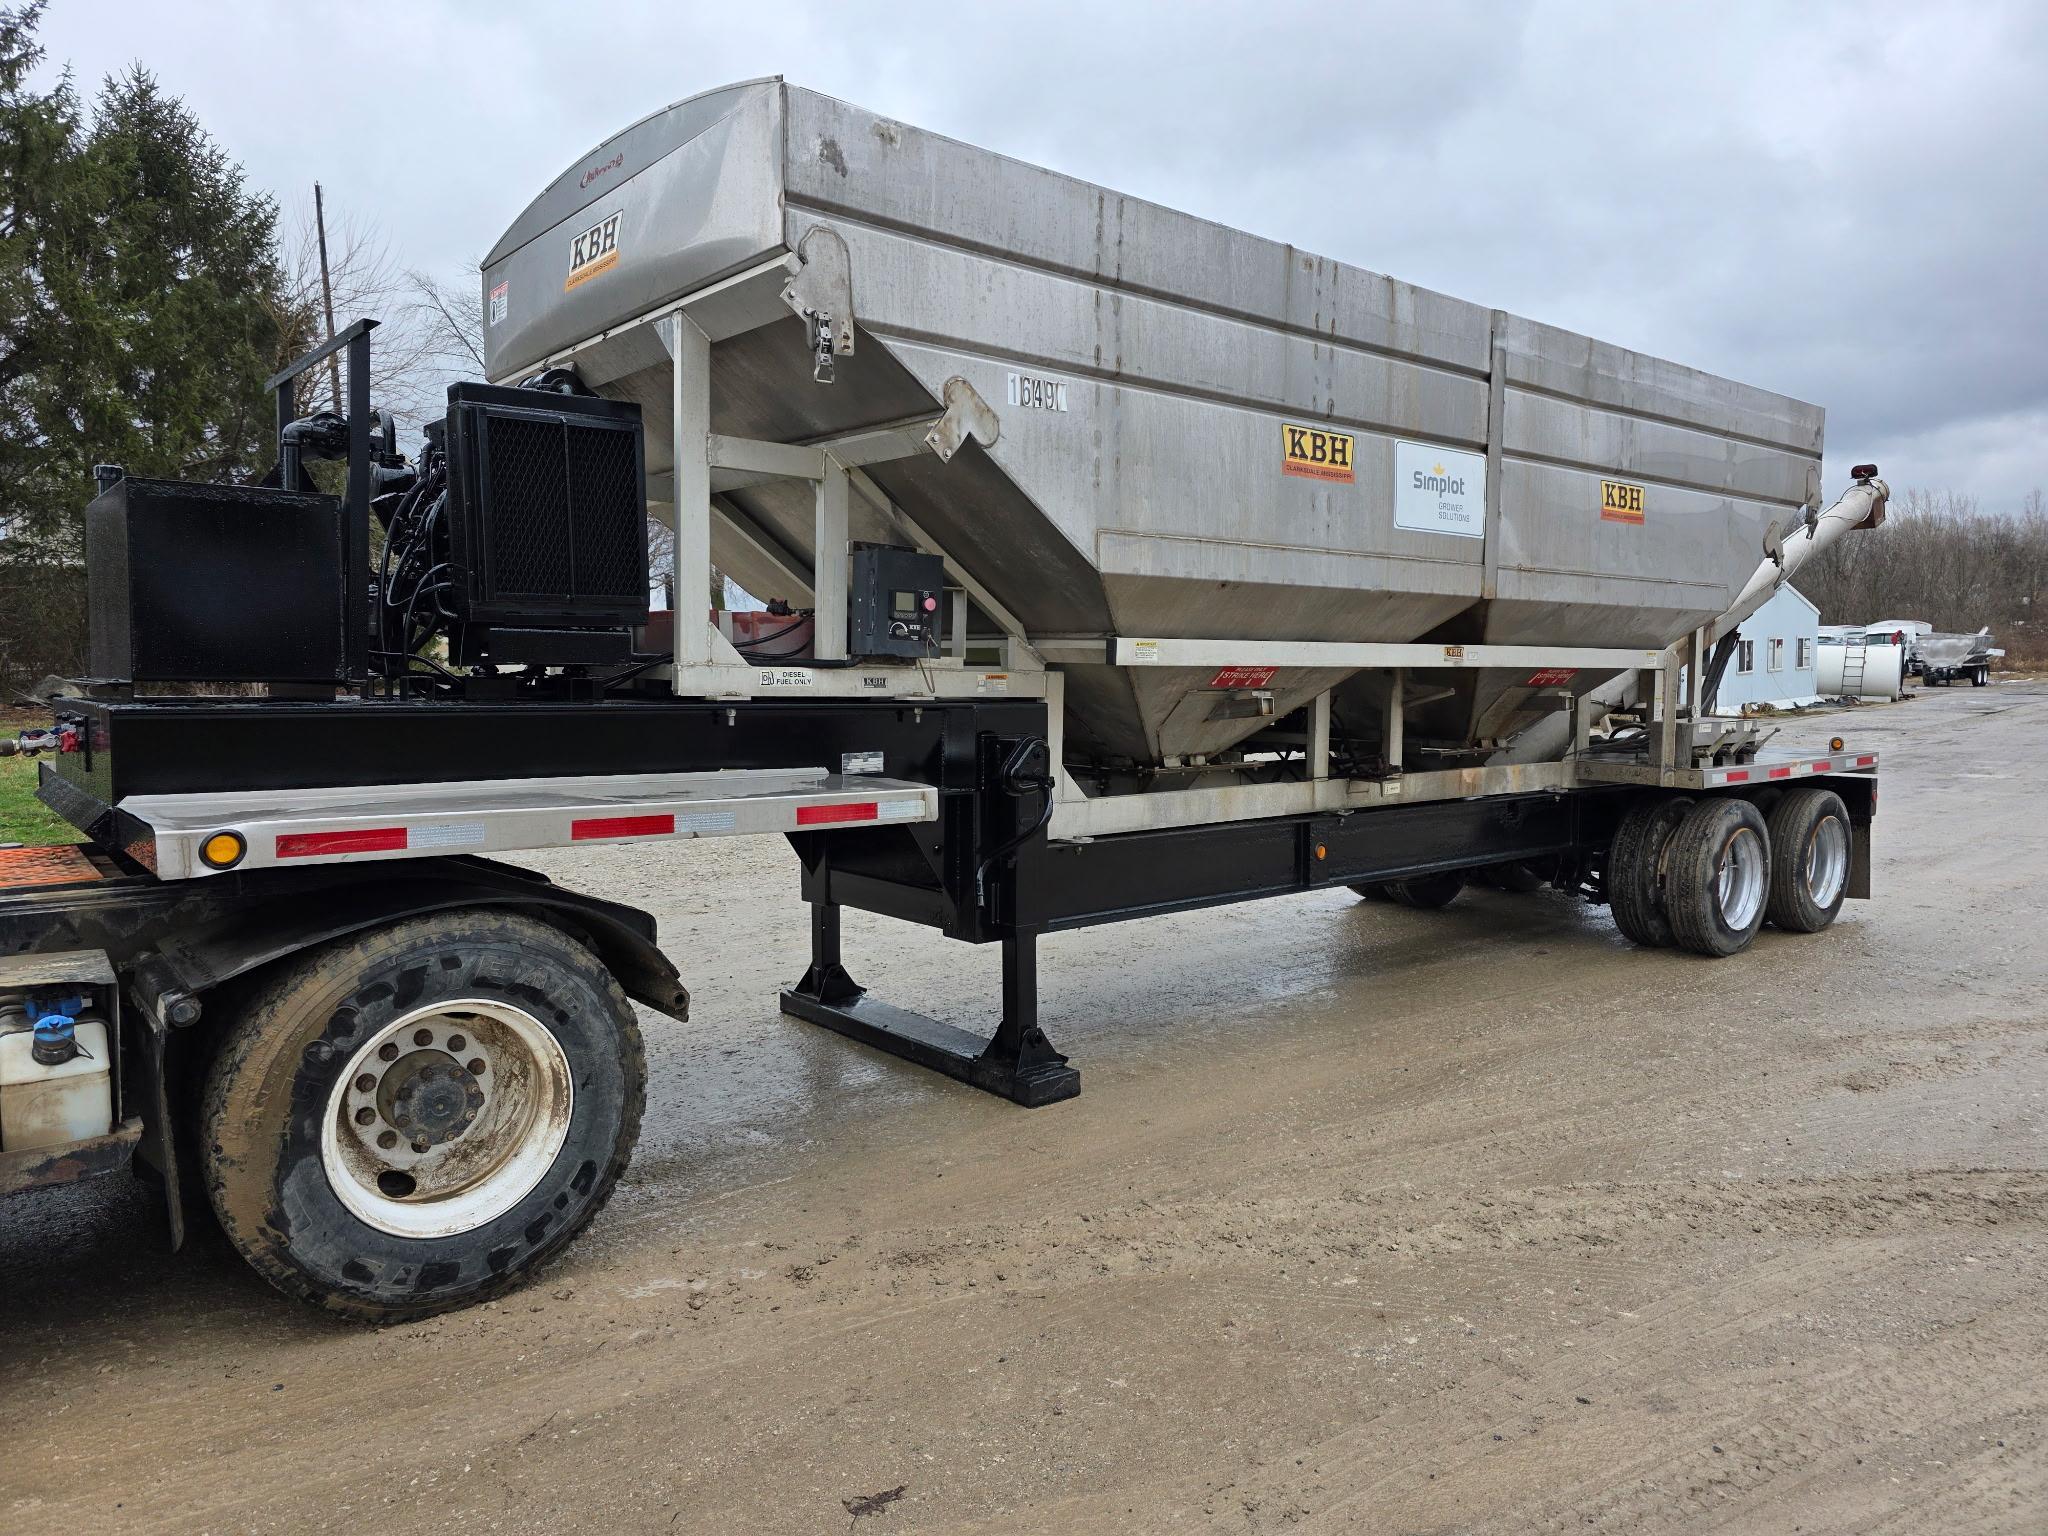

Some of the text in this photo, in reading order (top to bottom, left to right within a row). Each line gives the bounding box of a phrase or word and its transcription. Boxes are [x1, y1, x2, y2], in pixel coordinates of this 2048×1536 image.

[571, 216, 619, 270] KBH
[1289, 428, 1349, 466] KBH
[1413, 470, 1465, 499] Simplot
[1604, 483, 1642, 511] KBH
[1438, 502, 1463, 512] GROWER
[1438, 511, 1470, 523] SOLUTIONS
